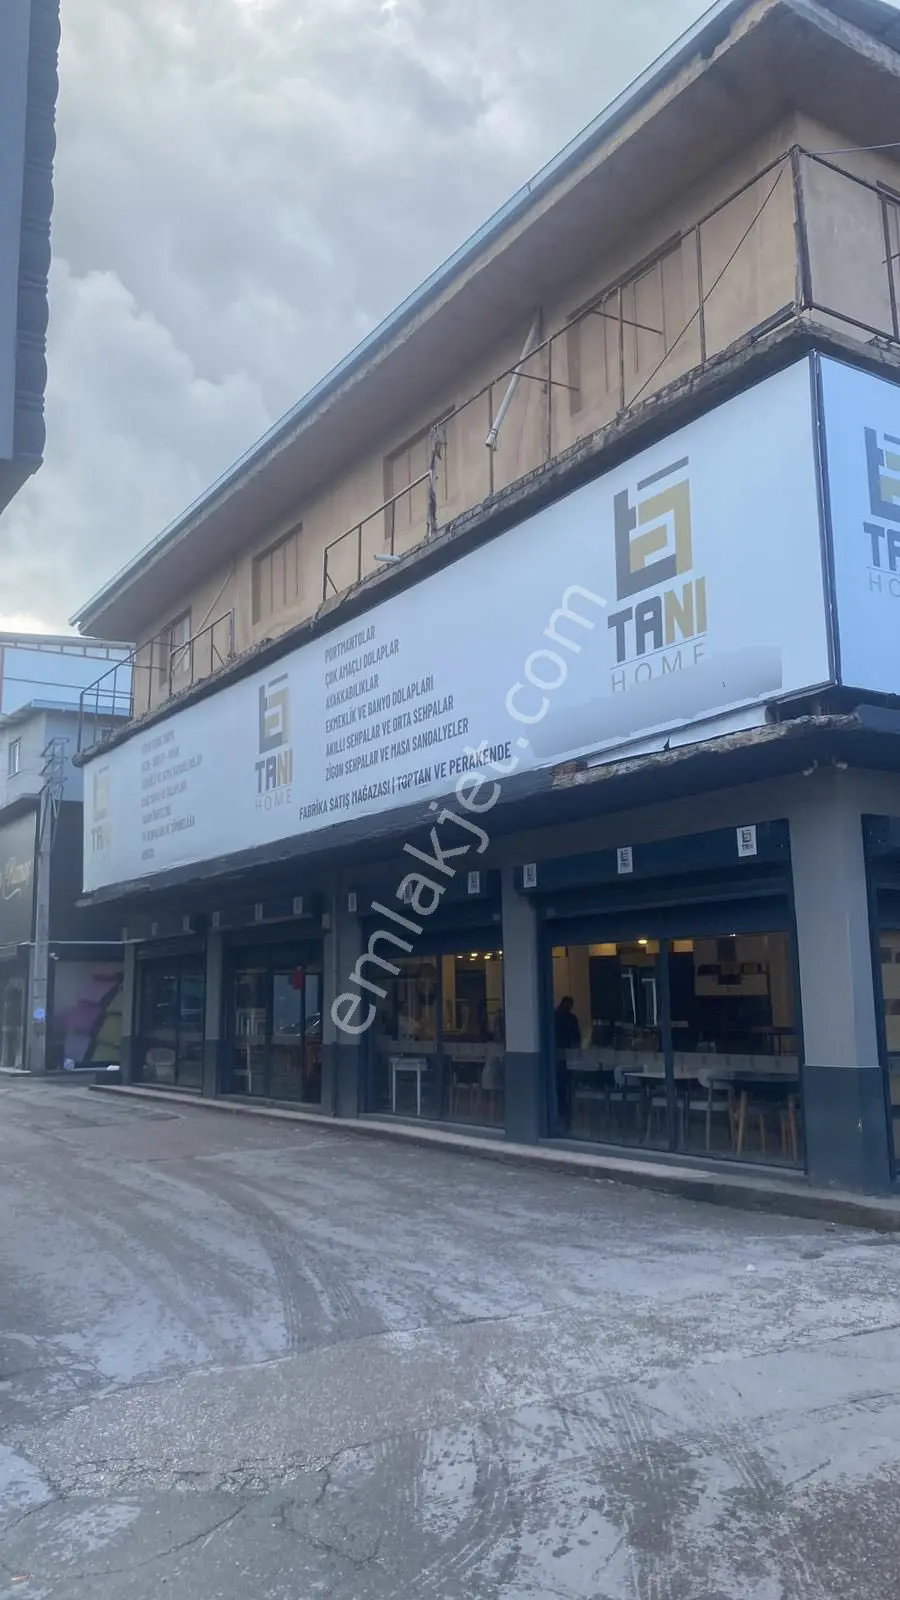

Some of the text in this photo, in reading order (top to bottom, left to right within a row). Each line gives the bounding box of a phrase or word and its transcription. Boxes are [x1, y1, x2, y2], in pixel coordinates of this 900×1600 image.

[325, 625, 376, 664] PORTMANTOLAR
[607, 575, 708, 664] TANI
[339, 656, 362, 681] AMAÇLI
[363, 638, 400, 668] DOLAPLAR
[325, 674, 434, 733] EKMEKLİK VE BANYO DOLAPLARI
[325, 694, 454, 757] AKILLI SEHPALAR VE ORTA SEHPALAR
[254, 749, 293, 793] TANI
[325, 717, 469, 781] ZİGON SEHPALAR VE MASA SANDALYELER
[255, 789, 292, 813] HOME
[299, 798, 328, 820] FABRİKA
[329, 792, 350, 810] SATIŞ
[351, 779, 391, 805] MAĞAZASI
[397, 766, 431, 791] TOPTAN
[433, 761, 447, 780] VE
[449, 741, 512, 776] PERAKENDE
